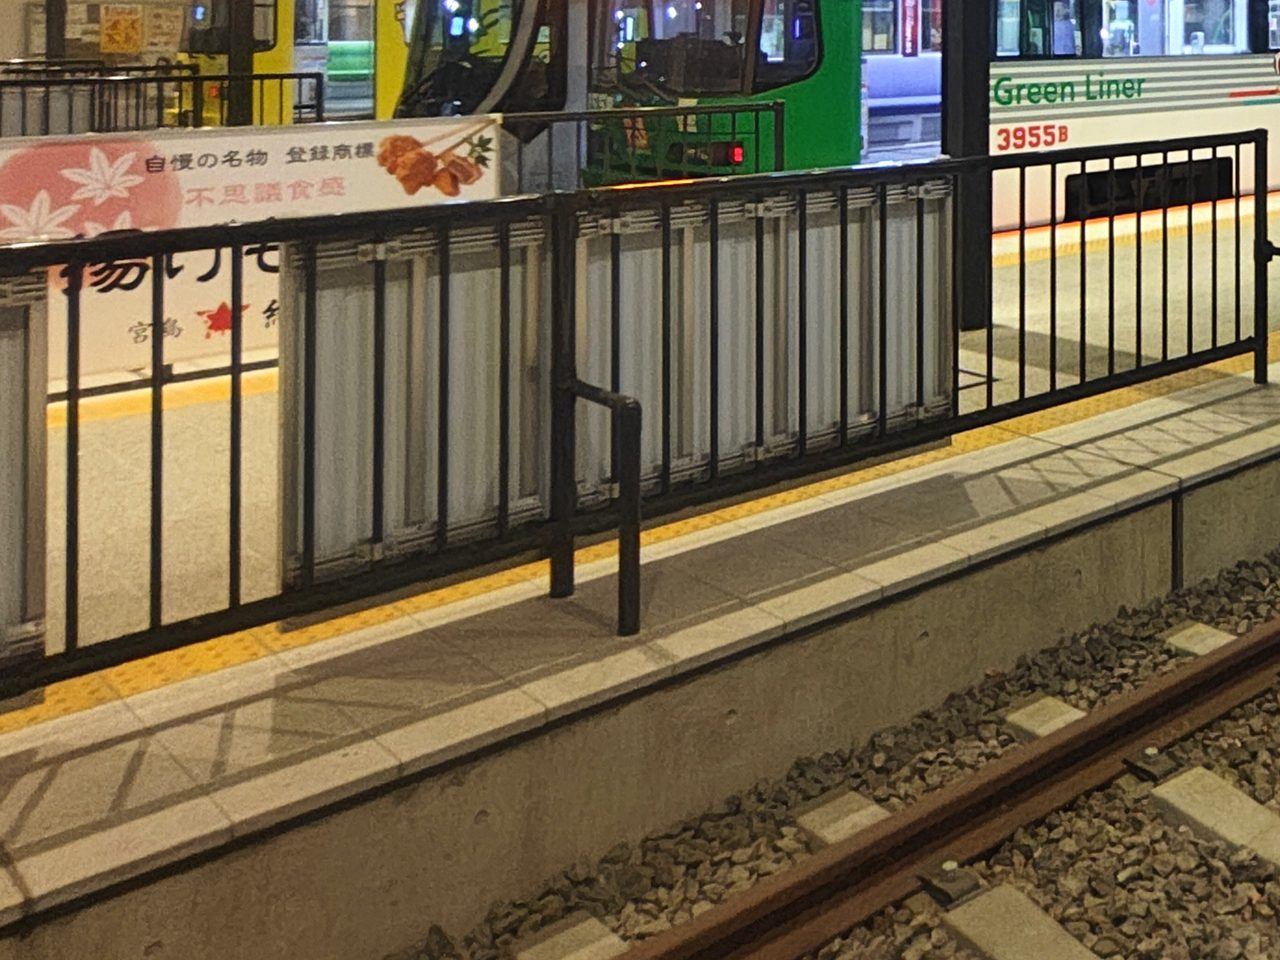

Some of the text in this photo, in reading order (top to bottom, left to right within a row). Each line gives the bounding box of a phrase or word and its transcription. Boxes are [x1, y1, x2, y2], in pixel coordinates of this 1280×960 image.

[994, 71, 1145, 106] Green Liner
[997, 124, 1068, 151] 3955B
[145, 142, 375, 173] 自慢の名物 登録商標
